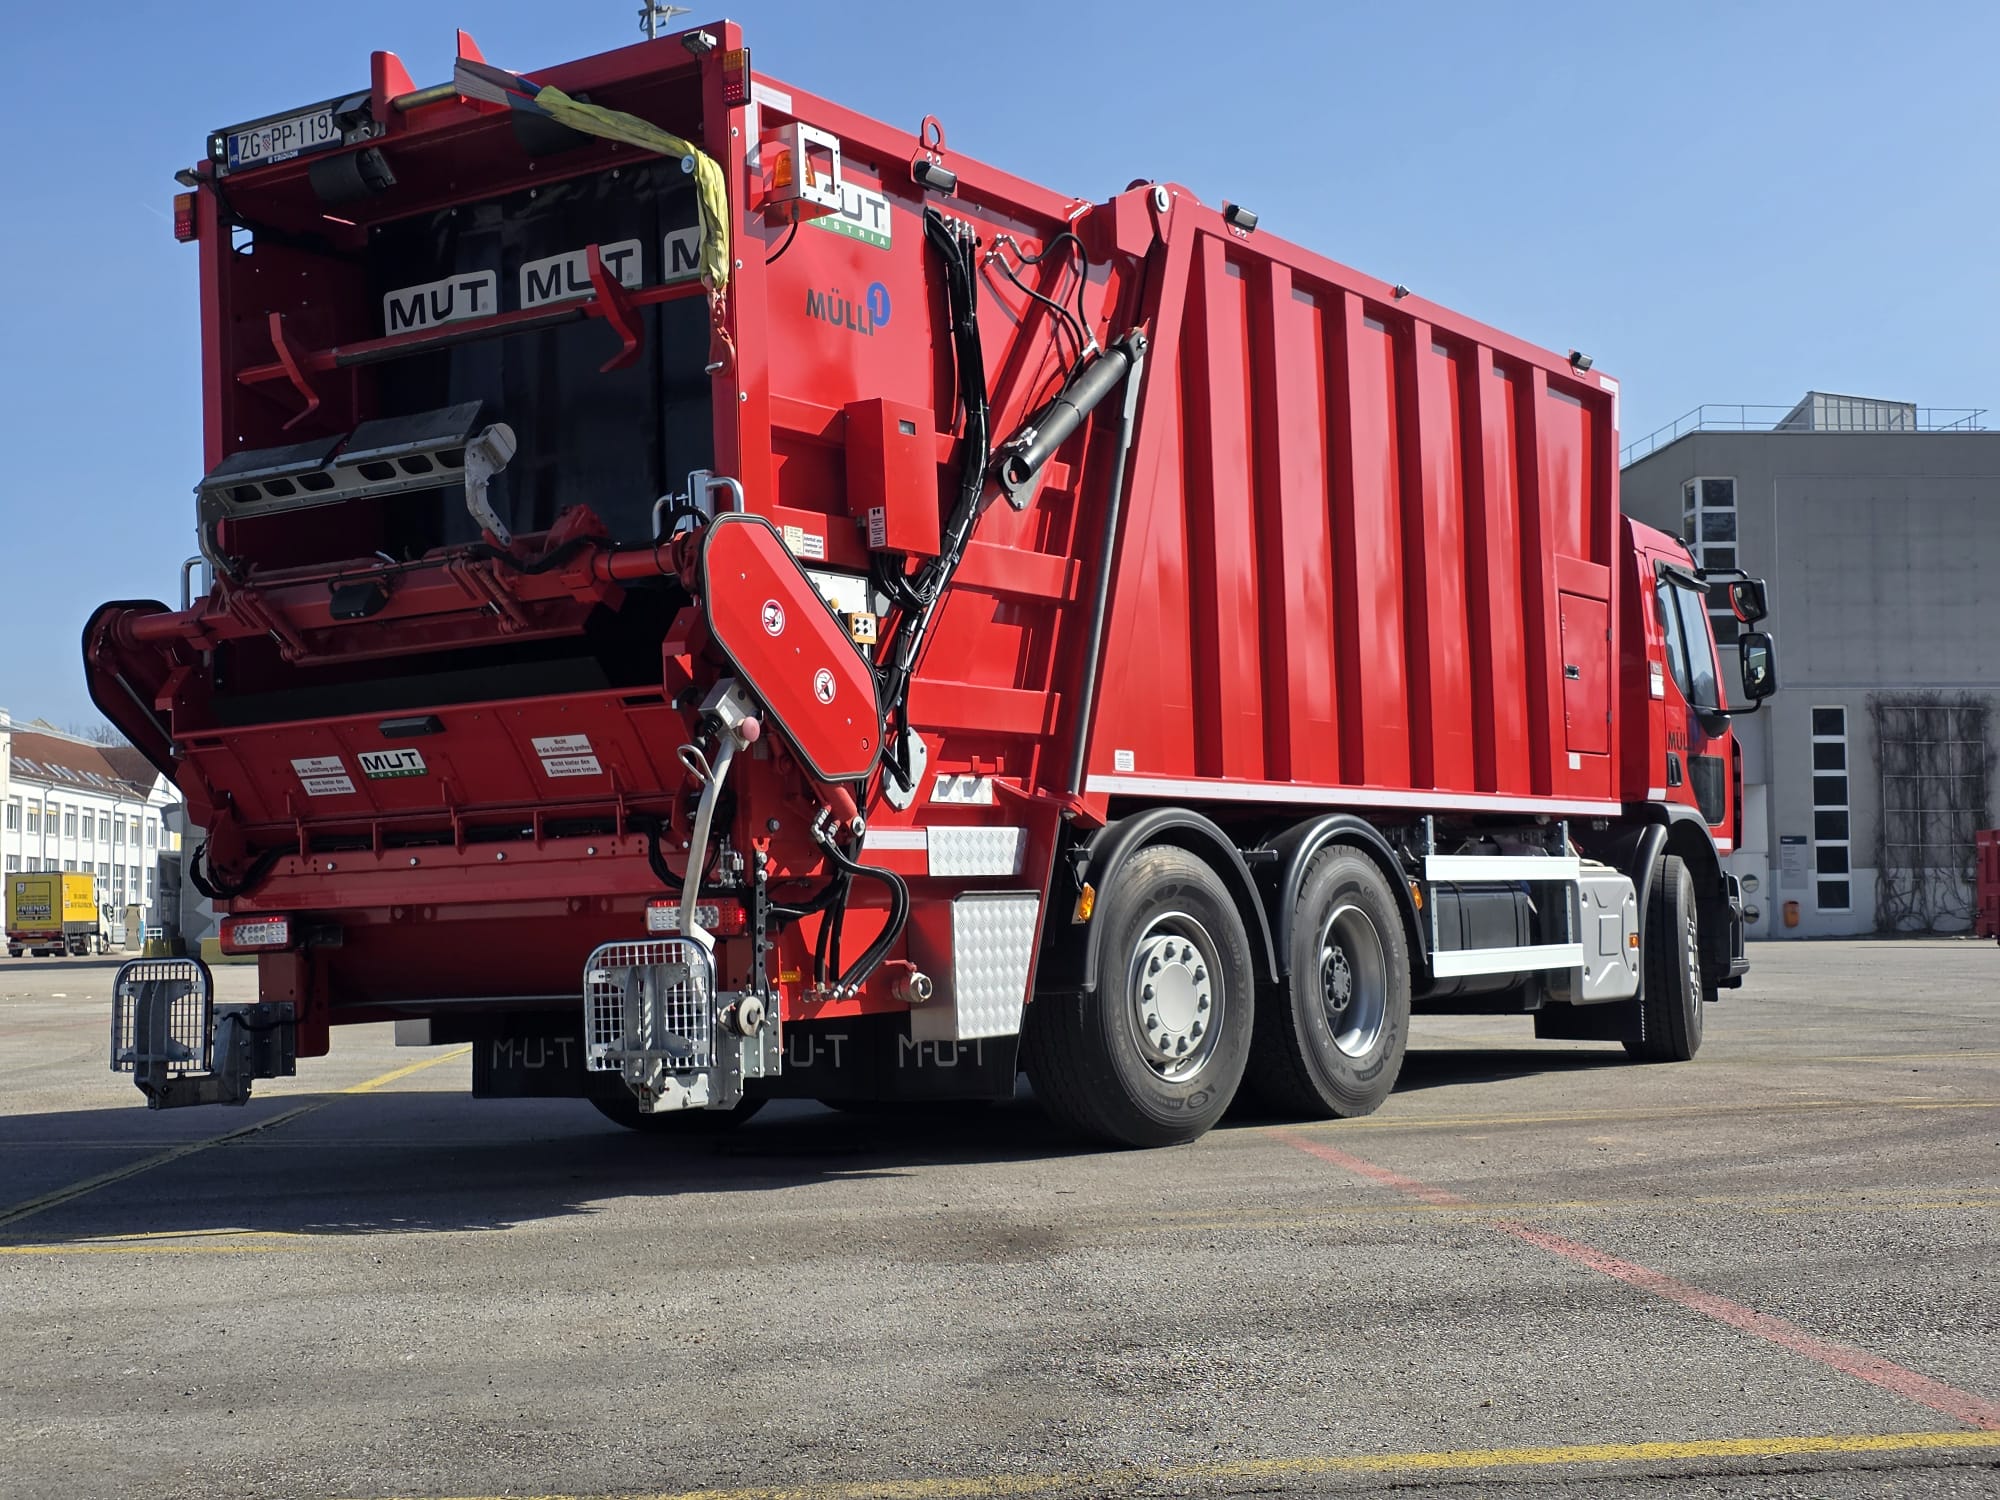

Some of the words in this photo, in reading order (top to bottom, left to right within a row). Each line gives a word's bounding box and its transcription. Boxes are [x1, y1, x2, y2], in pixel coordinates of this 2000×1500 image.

[240, 133, 260, 160] ZG
[825, 183, 885, 229] UT
[811, 217, 886, 246] USTRIA
[526, 248, 634, 303] MUT
[389, 278, 489, 331] MUT
[361, 752, 416, 771] MUT
[370, 769, 424, 778] AUSTRIA
[493, 1036, 575, 1069] M-U-T
